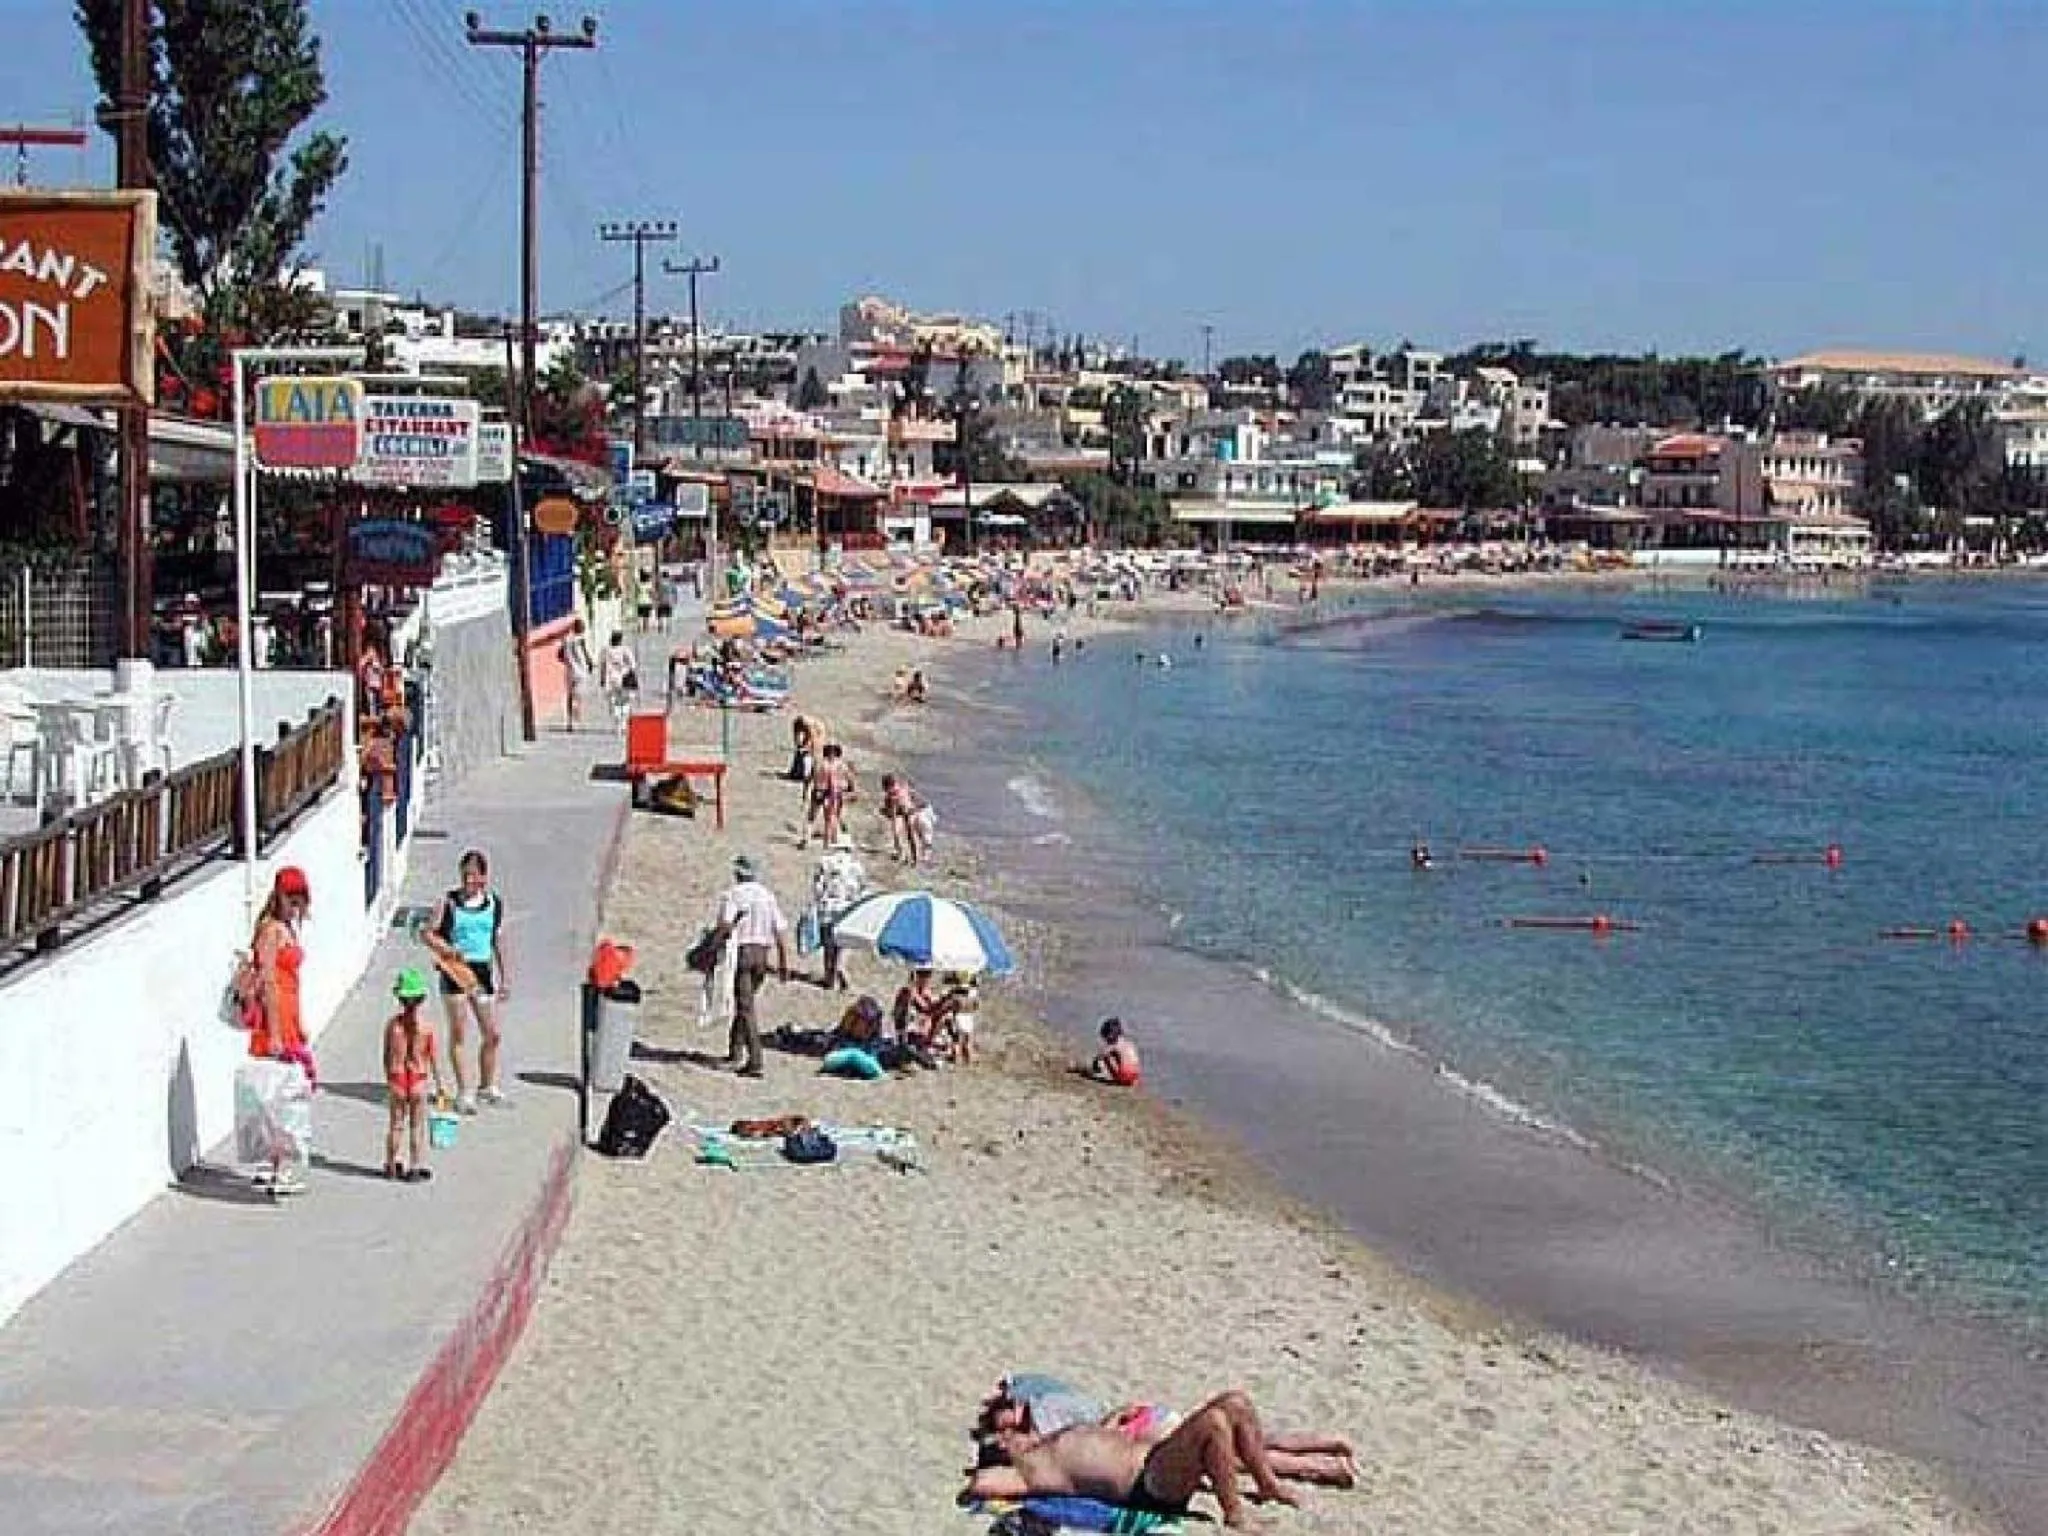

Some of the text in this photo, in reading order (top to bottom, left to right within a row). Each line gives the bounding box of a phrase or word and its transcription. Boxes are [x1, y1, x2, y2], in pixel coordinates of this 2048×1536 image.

[0, 239, 107, 298] ANT
[371, 402, 454, 417] TAVERNA
[364, 418, 471, 436] ESTAURANT
